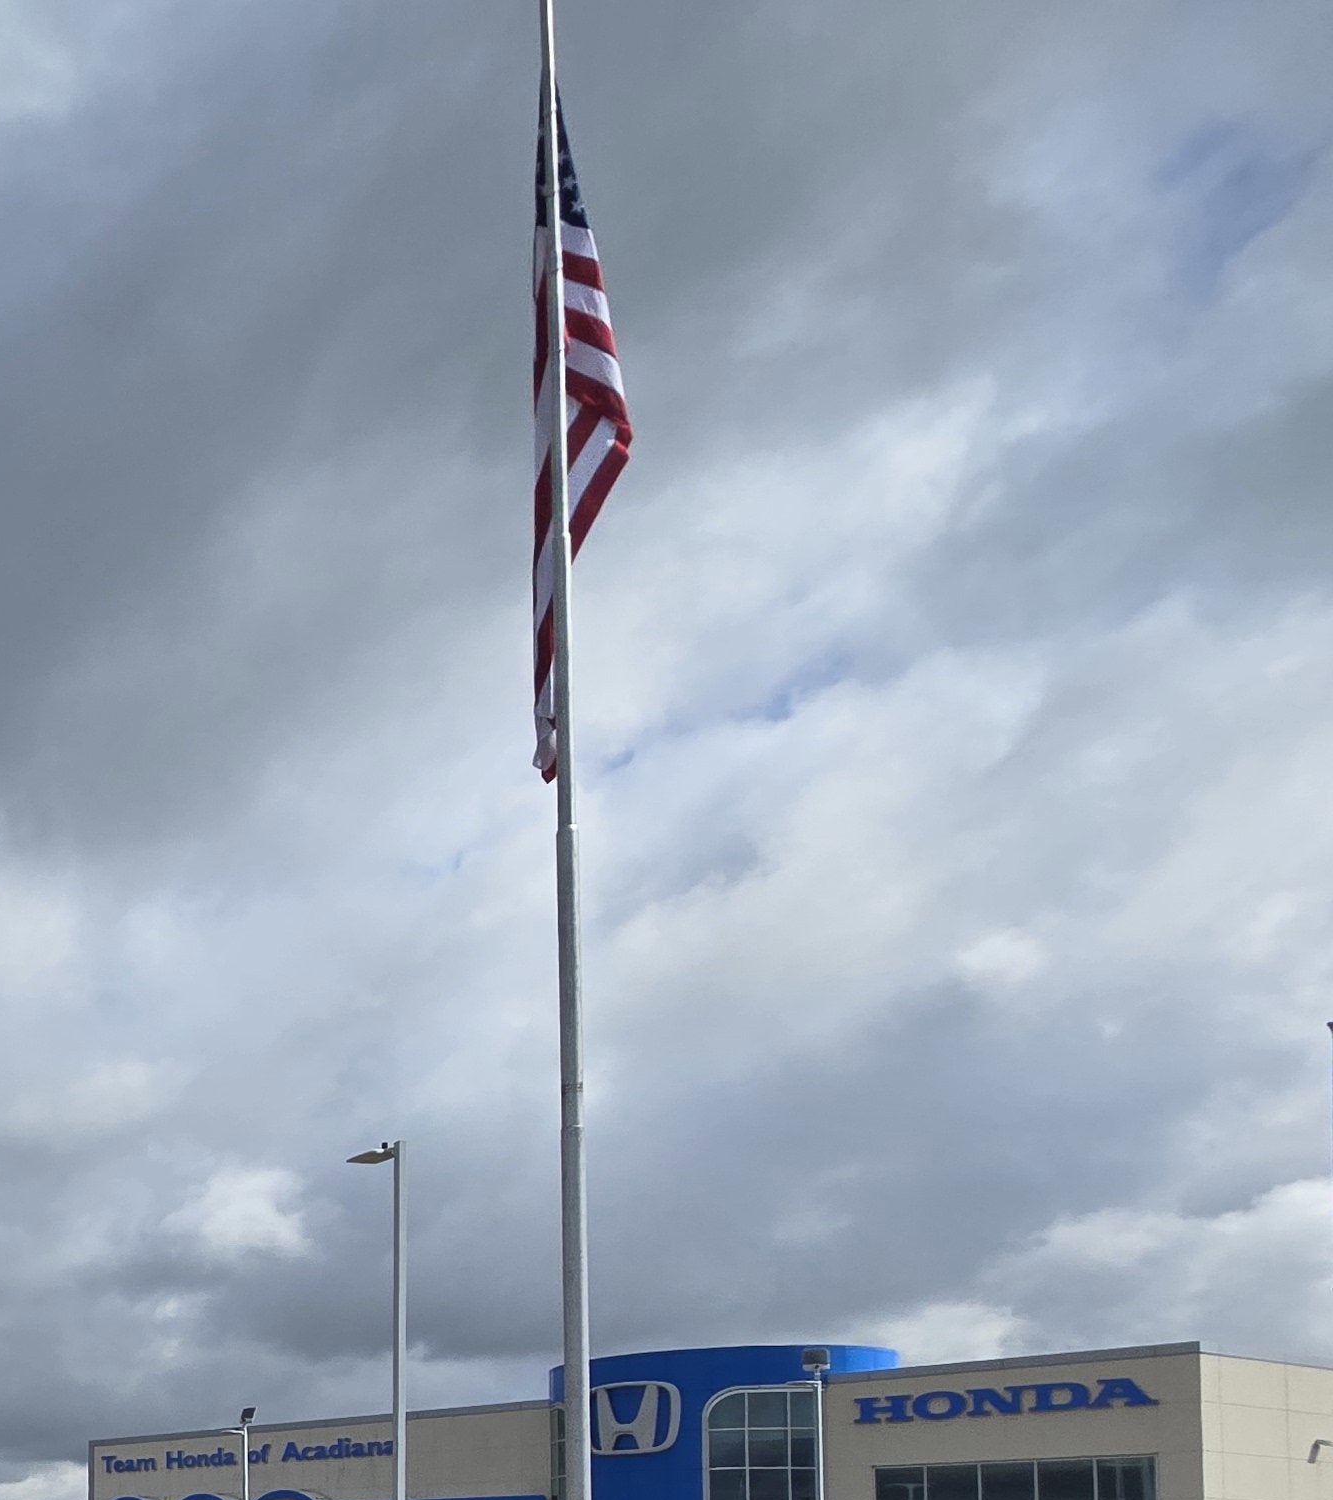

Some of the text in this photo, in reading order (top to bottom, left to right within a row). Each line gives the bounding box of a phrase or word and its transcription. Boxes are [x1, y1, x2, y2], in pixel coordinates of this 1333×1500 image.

[853, 1377, 1160, 1425] HONDA
[101, 1438, 394, 1473] Team Honda of Acadiana
